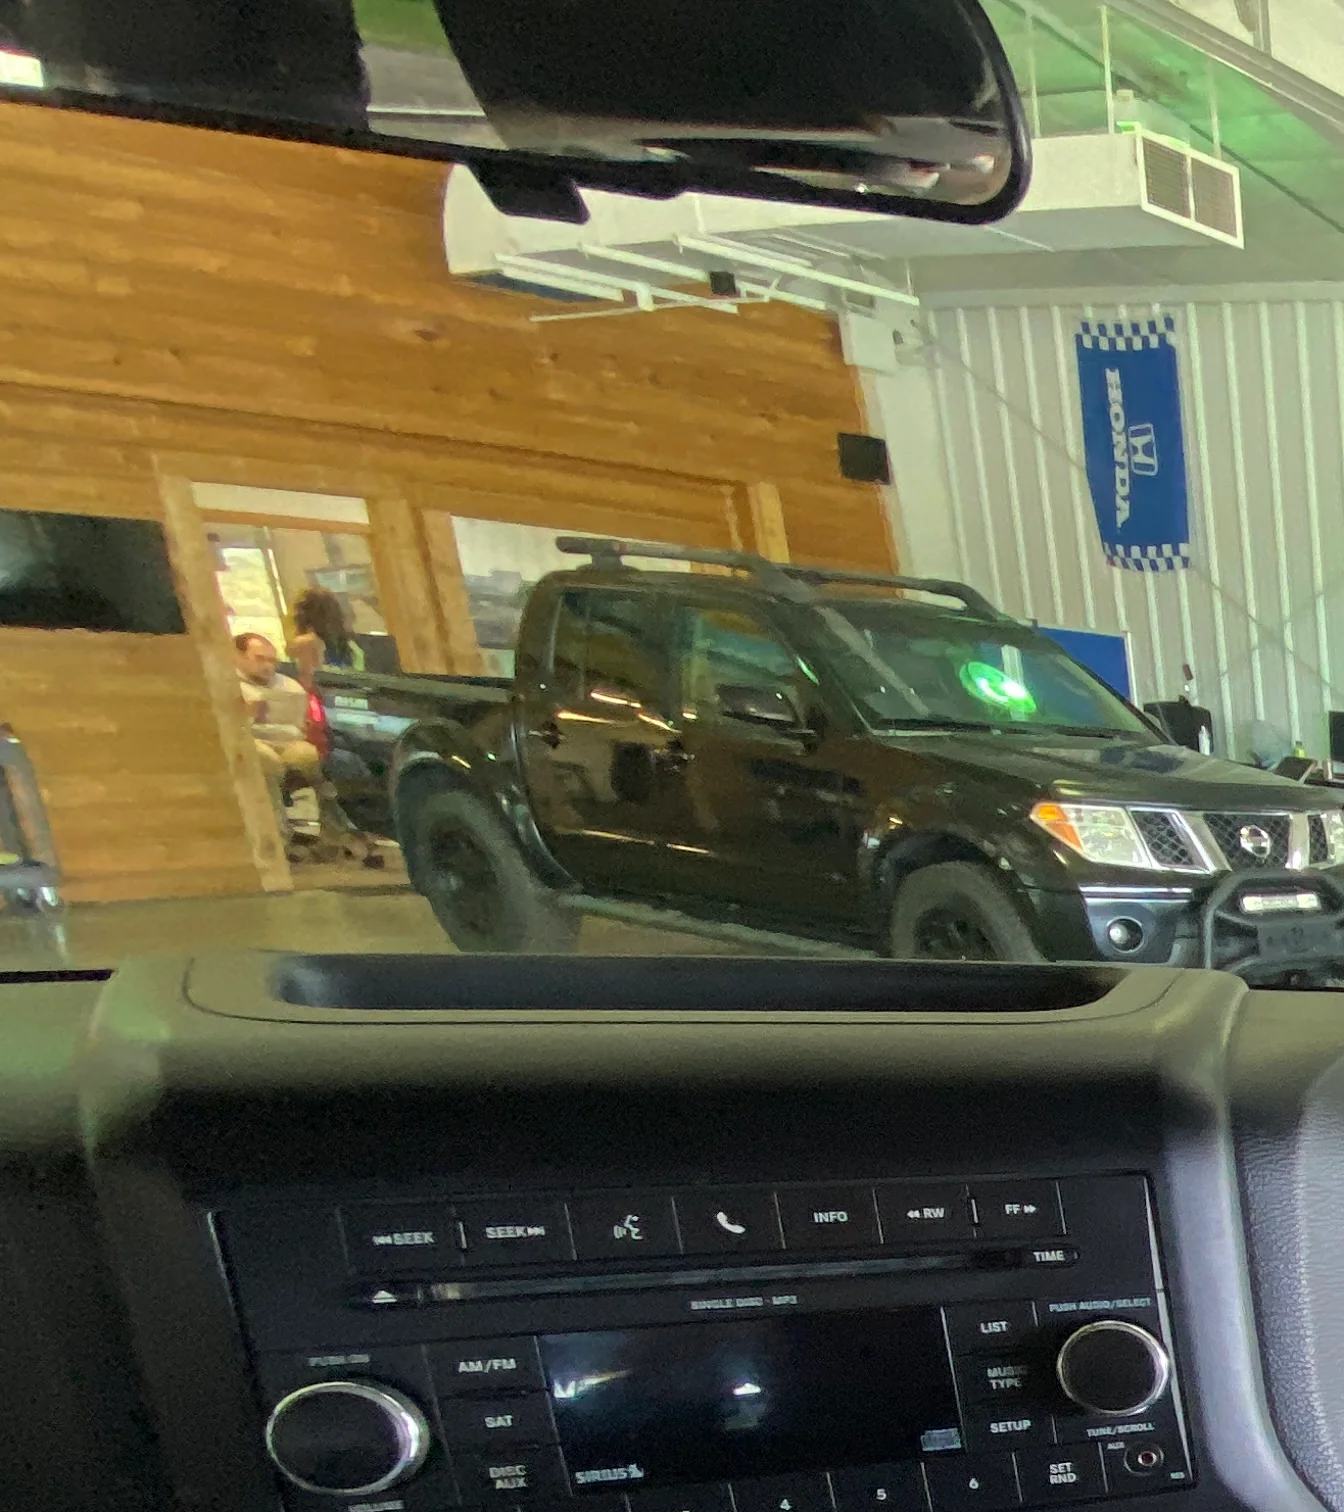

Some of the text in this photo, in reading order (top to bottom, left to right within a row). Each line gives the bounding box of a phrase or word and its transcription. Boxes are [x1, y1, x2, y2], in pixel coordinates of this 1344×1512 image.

[1105, 367, 1131, 530] HONDA
[922, 1206, 945, 1220] RW
[1004, 1203, 1021, 1216] FF
[812, 1210, 849, 1224] INFO
[393, 1230, 435, 1246] SEEK
[485, 1225, 529, 1240] SEEK
[1032, 1249, 1066, 1264] TIME
[1079, 1297, 1152, 1312] AUDIO/SELECT
[980, 1321, 1008, 1334] LIST
[458, 1358, 517, 1374] AM/FM
[484, 1414, 514, 1429] SAT
[989, 1419, 1031, 1434] SETUP
[1086, 1422, 1155, 1438] TUNE/SCROLL
[1049, 1462, 1073, 1475] SET
[968, 1477, 979, 1490] 6
[1049, 1473, 1077, 1485] RND
[876, 1488, 887, 1501] 5
[780, 1498, 792, 1511] 4
